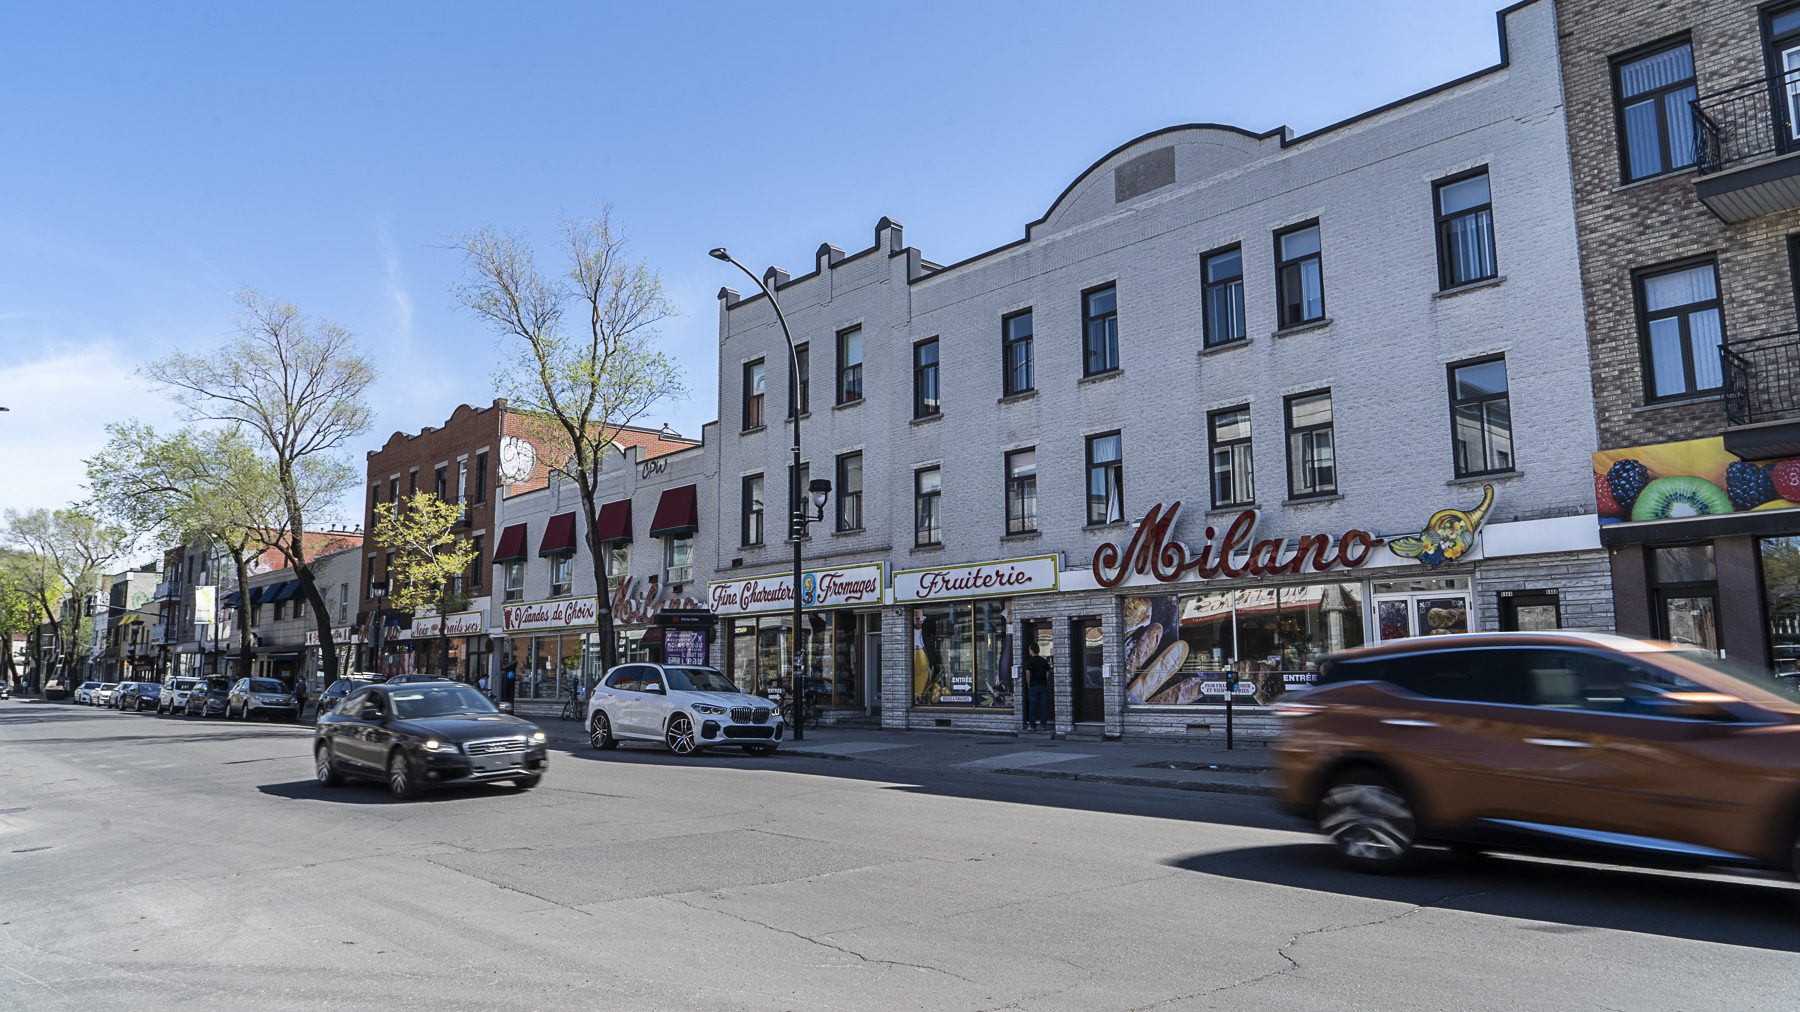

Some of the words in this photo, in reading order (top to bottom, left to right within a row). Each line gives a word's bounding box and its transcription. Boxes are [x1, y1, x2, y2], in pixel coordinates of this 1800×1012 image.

[1092, 500, 1385, 588] Milano
[711, 584, 738, 613] Fine
[739, 581, 795, 611] Charcuteri
[817, 572, 877, 603] Fromages
[916, 566, 1033, 599] Fruiterie
[515, 605, 550, 629] Viandes
[551, 603, 563, 621] de
[564, 601, 594, 625] Choix
[1283, 672, 1318, 682] ENTRÉE
